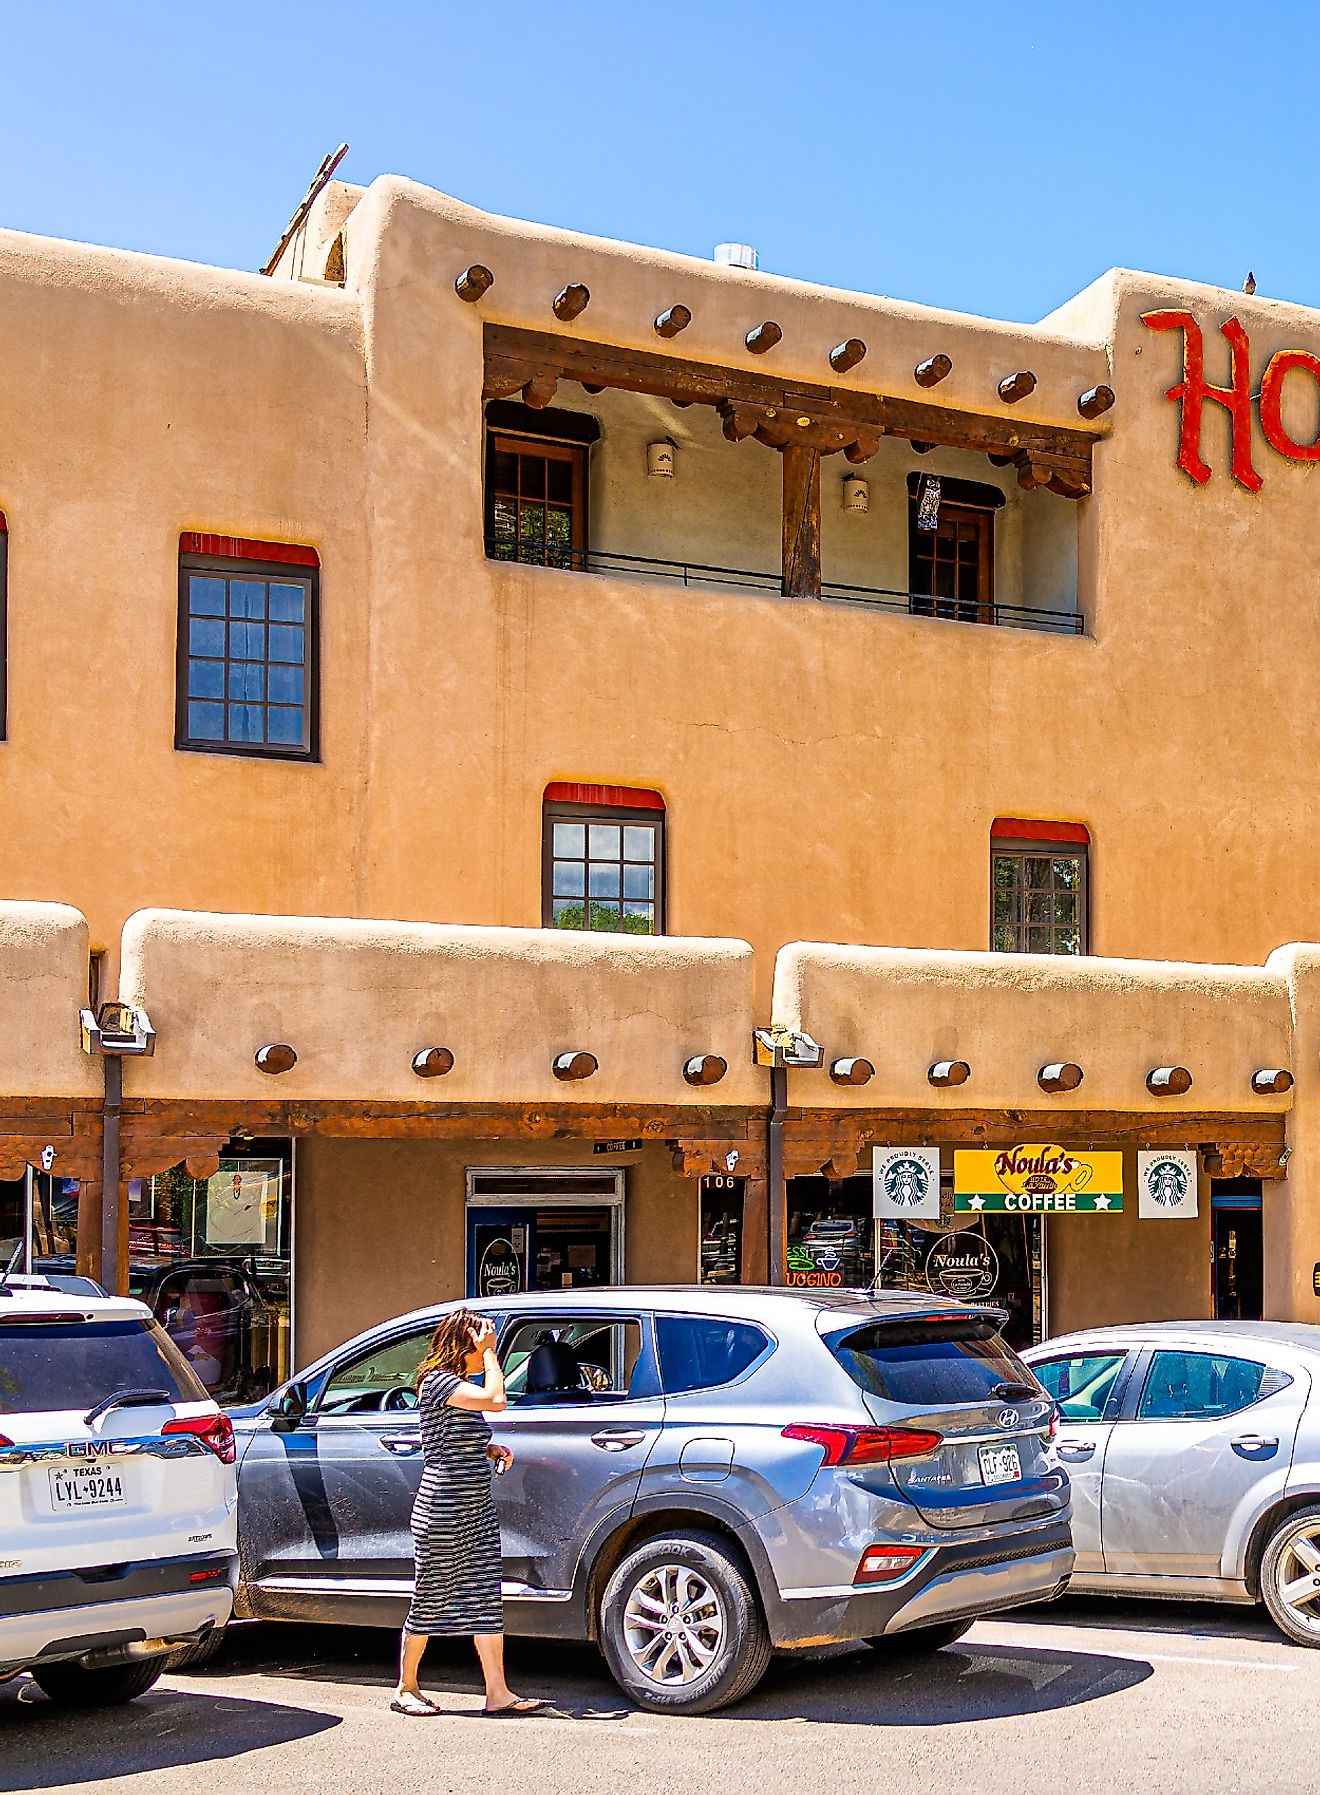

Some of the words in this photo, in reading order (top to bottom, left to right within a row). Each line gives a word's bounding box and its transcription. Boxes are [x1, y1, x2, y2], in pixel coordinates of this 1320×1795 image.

[998, 1146, 1074, 1176] Noula's
[704, 1176, 735, 1189] 106
[1004, 1193, 1077, 1211] COFFEE
[933, 1253, 991, 1268] Noula's
[484, 1261, 517, 1277] Noula's
[66, 1441, 127, 1458] GMC
[73, 1466, 103, 1478] TEXAS
